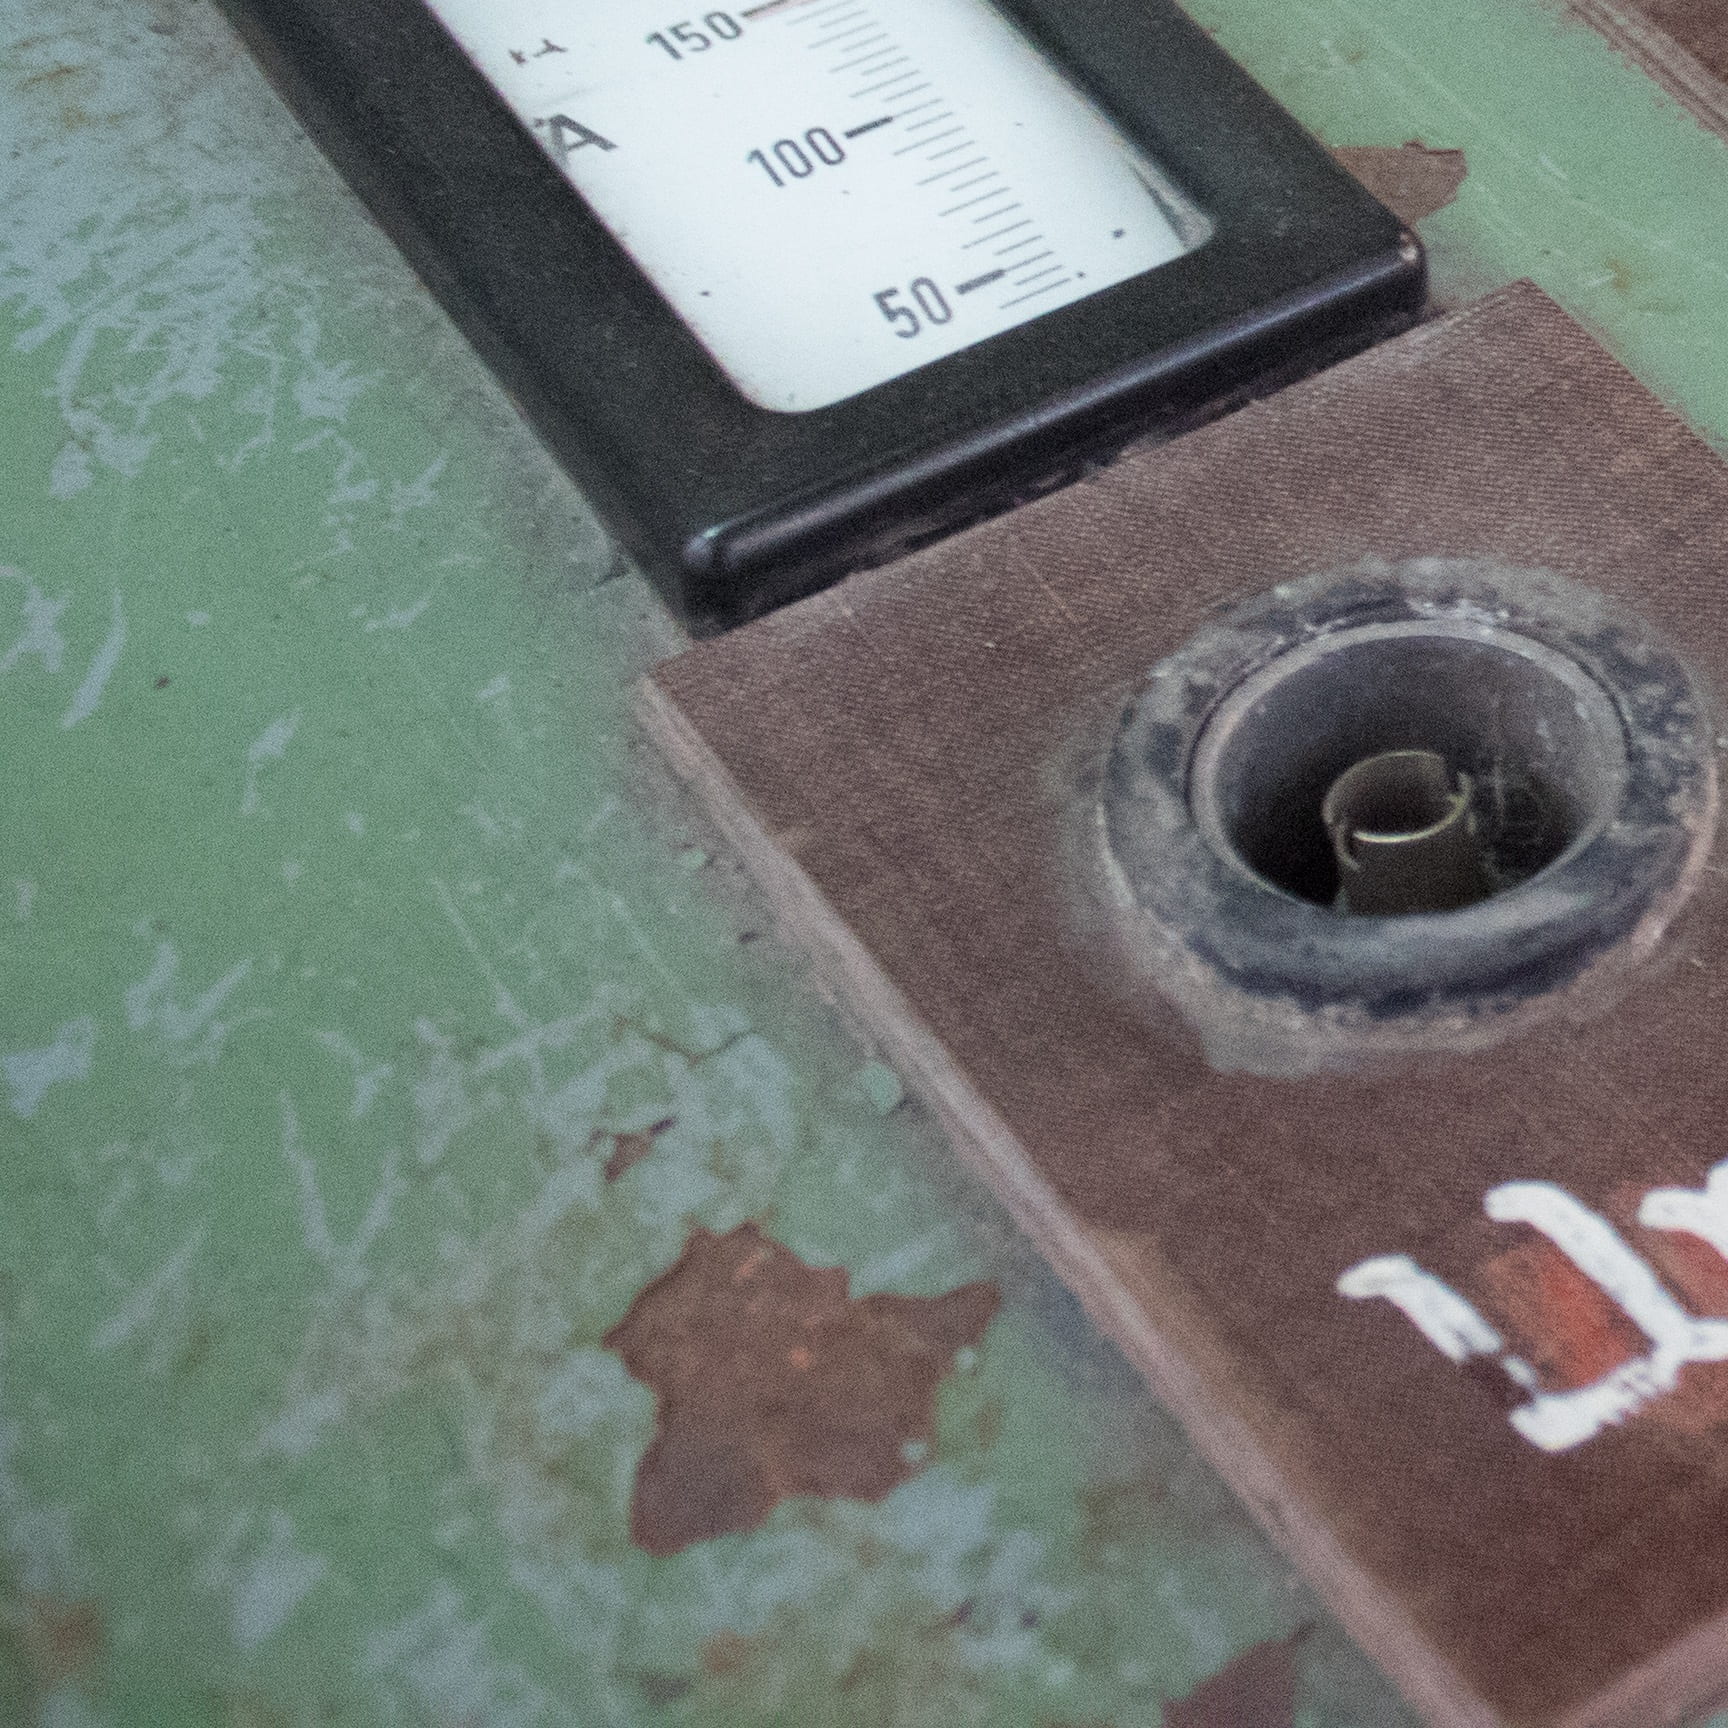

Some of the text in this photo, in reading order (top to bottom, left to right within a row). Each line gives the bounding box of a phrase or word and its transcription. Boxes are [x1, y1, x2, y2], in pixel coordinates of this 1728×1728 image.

[645, 10, 743, 61] 150
[746, 126, 846, 188] 100
[873, 276, 953, 339] 50
